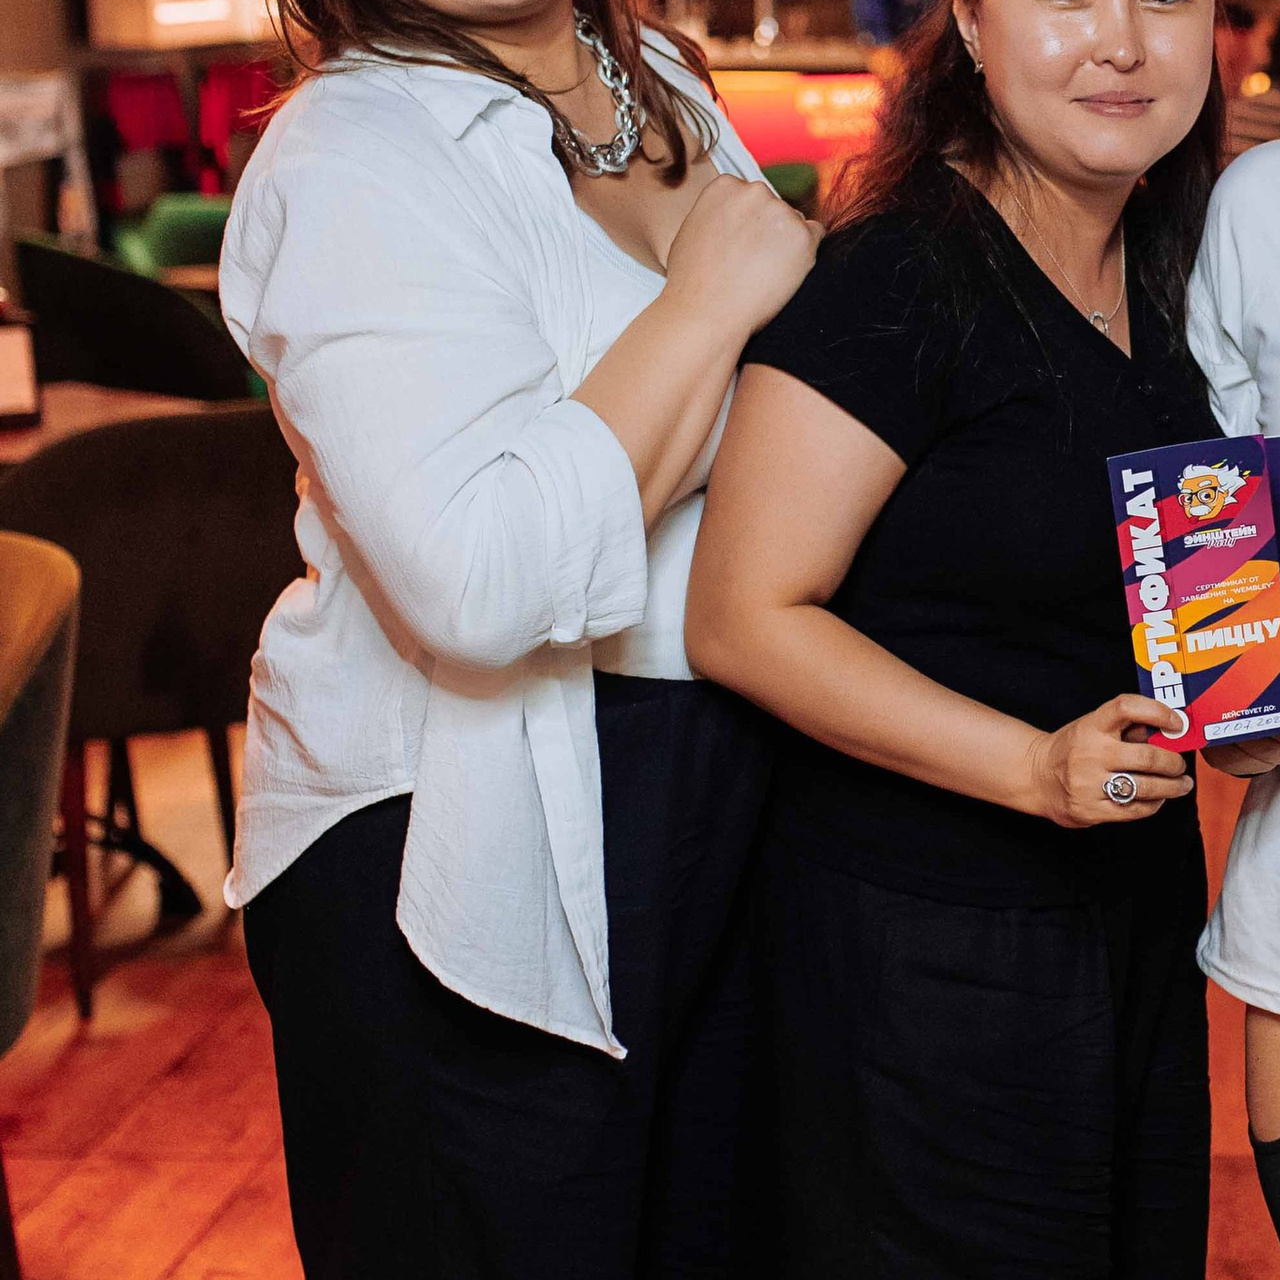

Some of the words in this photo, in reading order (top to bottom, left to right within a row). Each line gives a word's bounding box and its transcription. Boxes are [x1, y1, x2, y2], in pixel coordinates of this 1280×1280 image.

[1195, 578, 1247, 592] СЕРТИФИКАТ
[1180, 589, 1227, 603] ЗАВЕДЕНИЯ
[1221, 706, 1262, 721] ДЕЙСТВУЕТ
